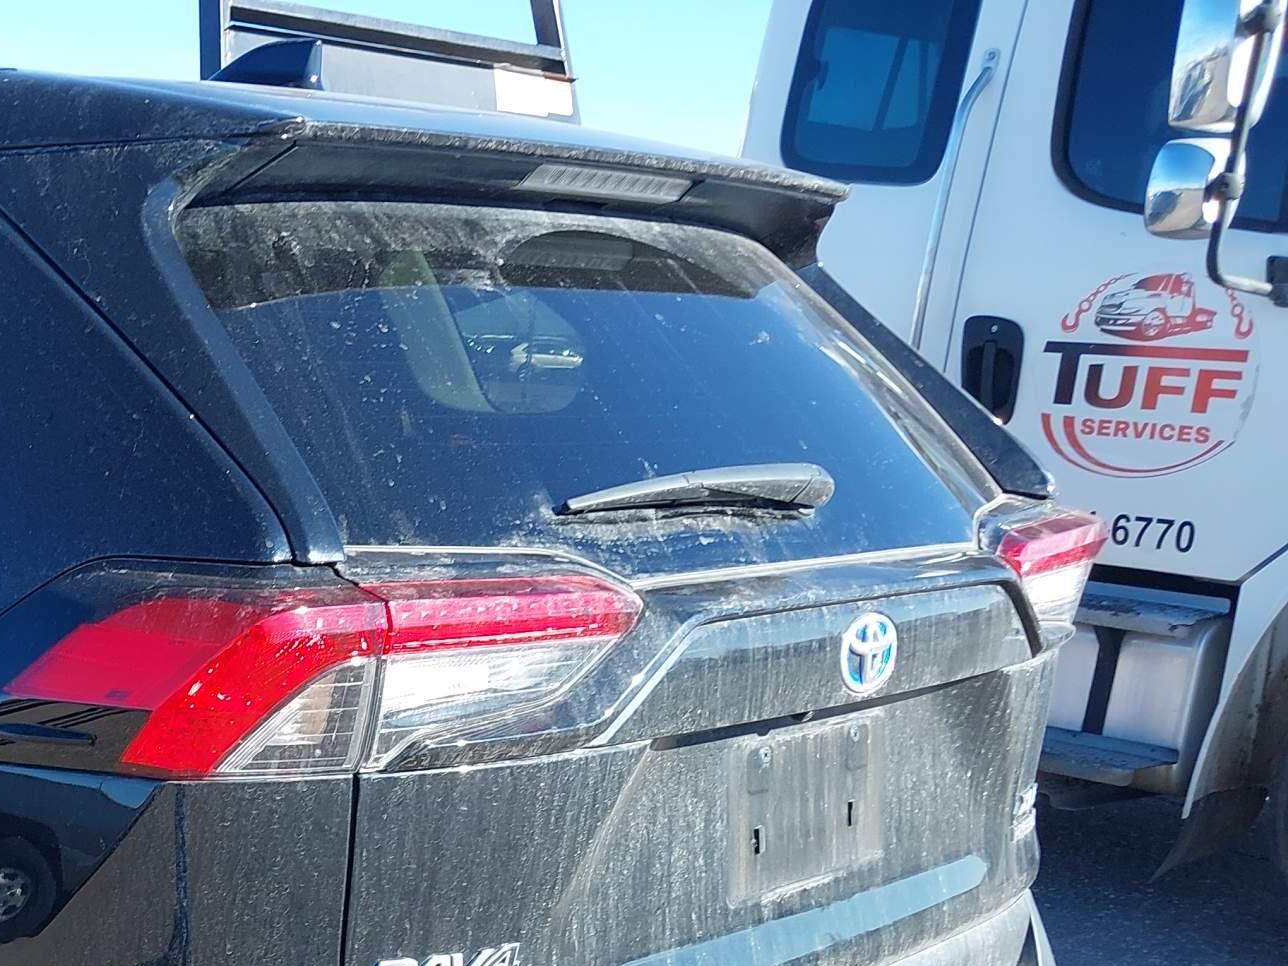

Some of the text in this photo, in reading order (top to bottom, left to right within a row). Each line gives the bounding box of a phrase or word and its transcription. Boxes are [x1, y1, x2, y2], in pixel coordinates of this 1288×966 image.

[1043, 341, 1250, 414] TUFF
[1079, 418, 1211, 444] SERVICES
[1111, 513, 1196, 553] 6770
